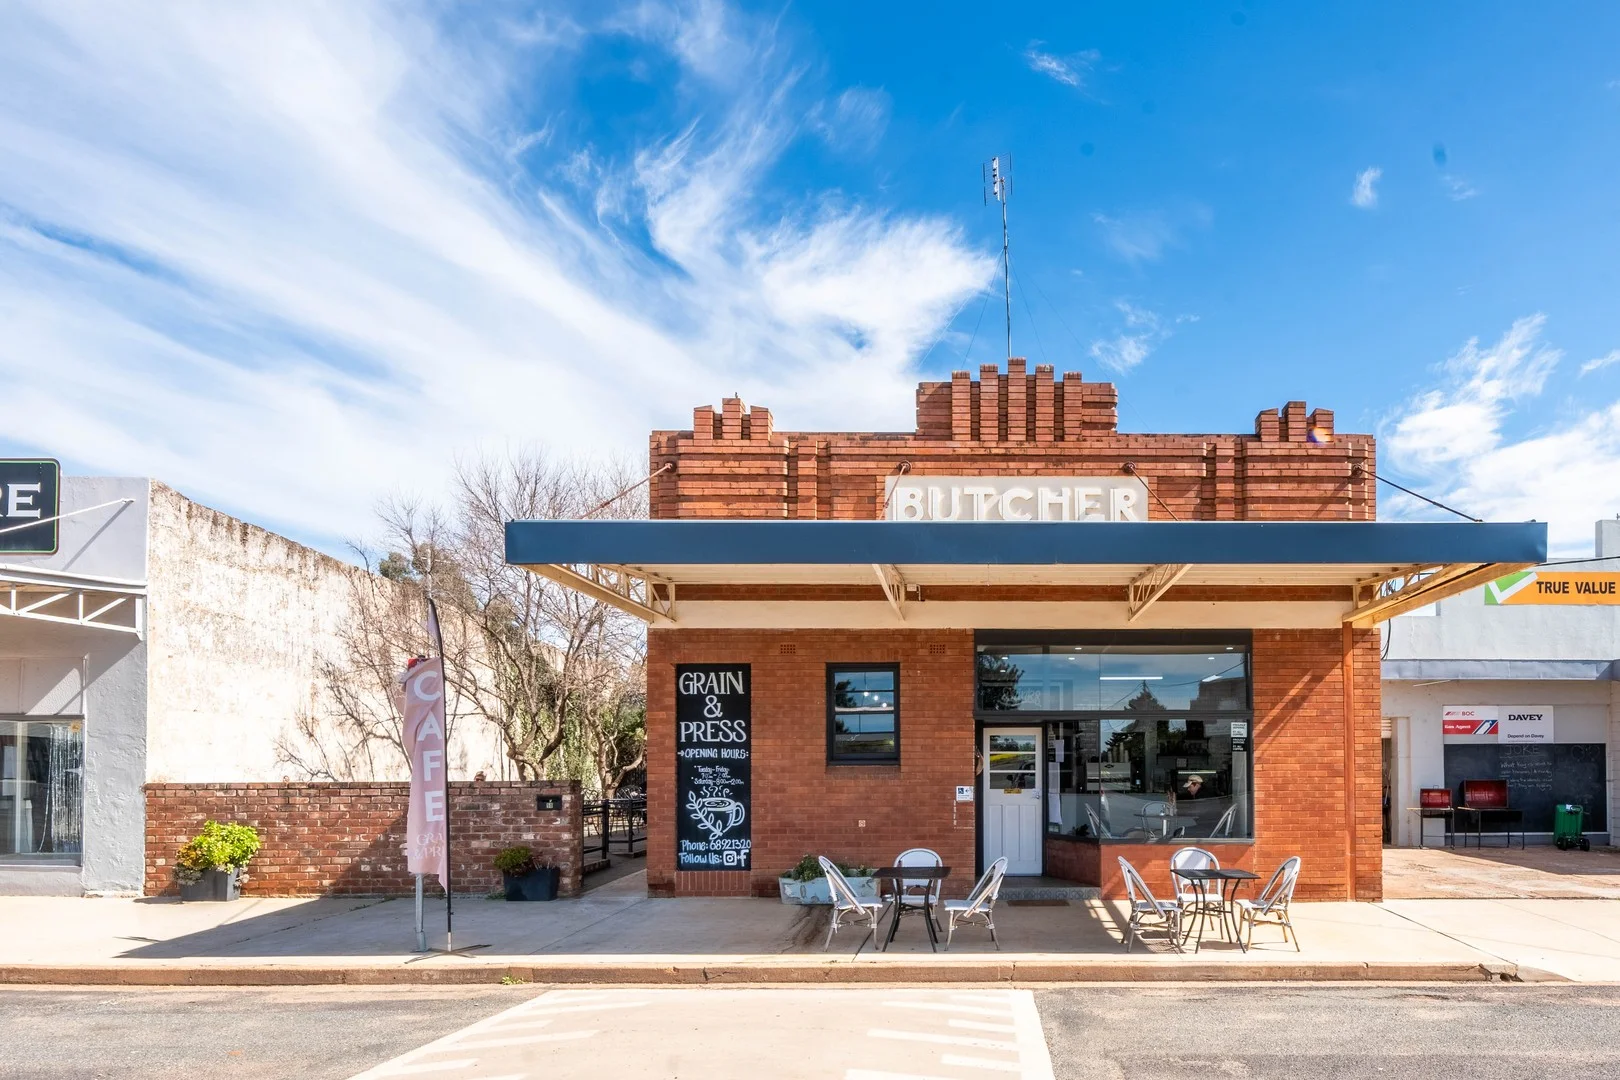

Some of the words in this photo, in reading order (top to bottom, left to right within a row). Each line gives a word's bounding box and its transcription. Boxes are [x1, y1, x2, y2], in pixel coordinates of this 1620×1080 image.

[892, 486, 1139, 522] BUTCHER
[1536, 581, 1570, 594] TRUE
[1574, 581, 1616, 594] VALUE
[679, 671, 745, 695] GRAIN
[703, 695, 724, 718] &
[680, 719, 747, 743] PRESS
[413, 671, 444, 822] CAFE
[685, 748, 718, 758] OPENING
[721, 748, 749, 759] HOURS:
[1505, 745, 1541, 755] JOKE
[680, 839, 709, 851] Phone:
[709, 839, 752, 850] 68921320
[678, 852, 707, 864] Follow
[709, 852, 722, 864] Us:
